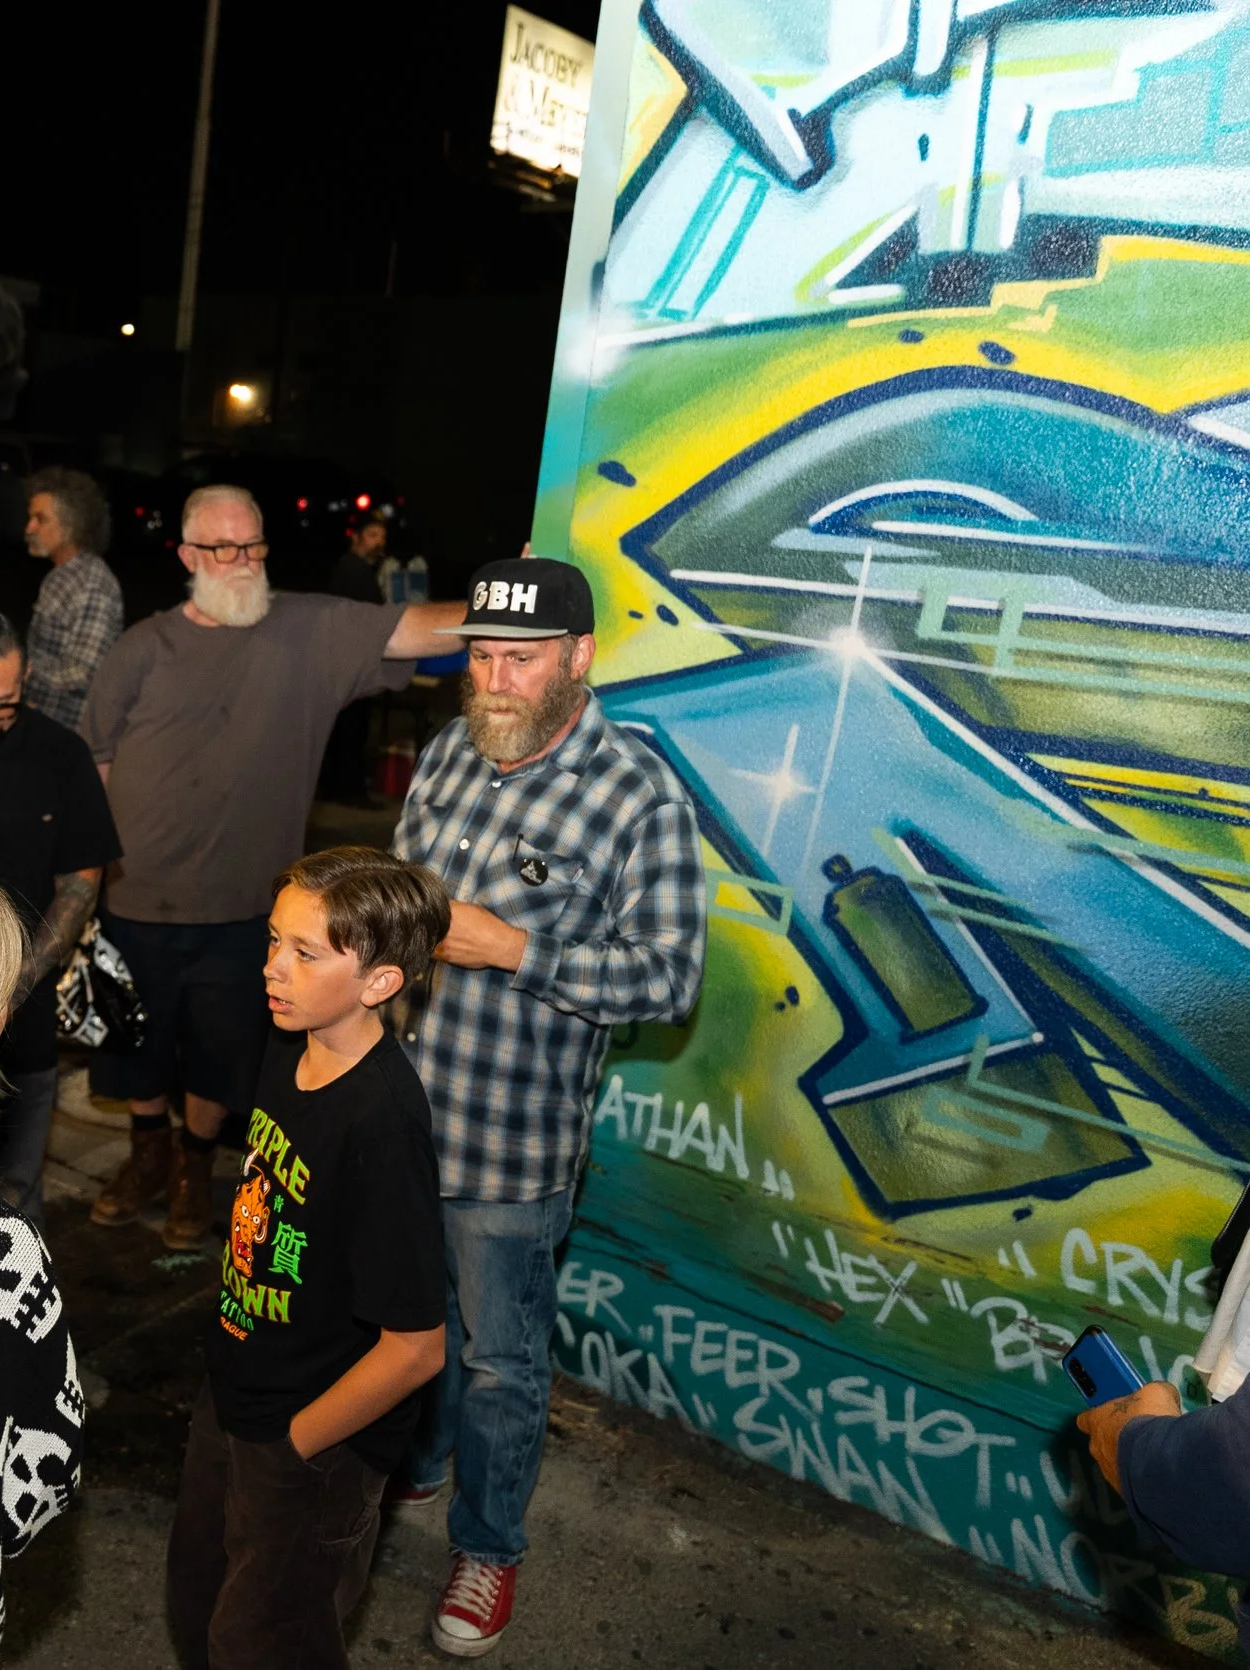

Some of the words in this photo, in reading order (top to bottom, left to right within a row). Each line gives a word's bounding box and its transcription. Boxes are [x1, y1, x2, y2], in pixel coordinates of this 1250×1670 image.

[510, 22, 584, 88] JACOBY
[472, 580, 539, 614] GBH
[594, 1074, 750, 1179] ATHAN
[804, 1229, 930, 1326] HEX
